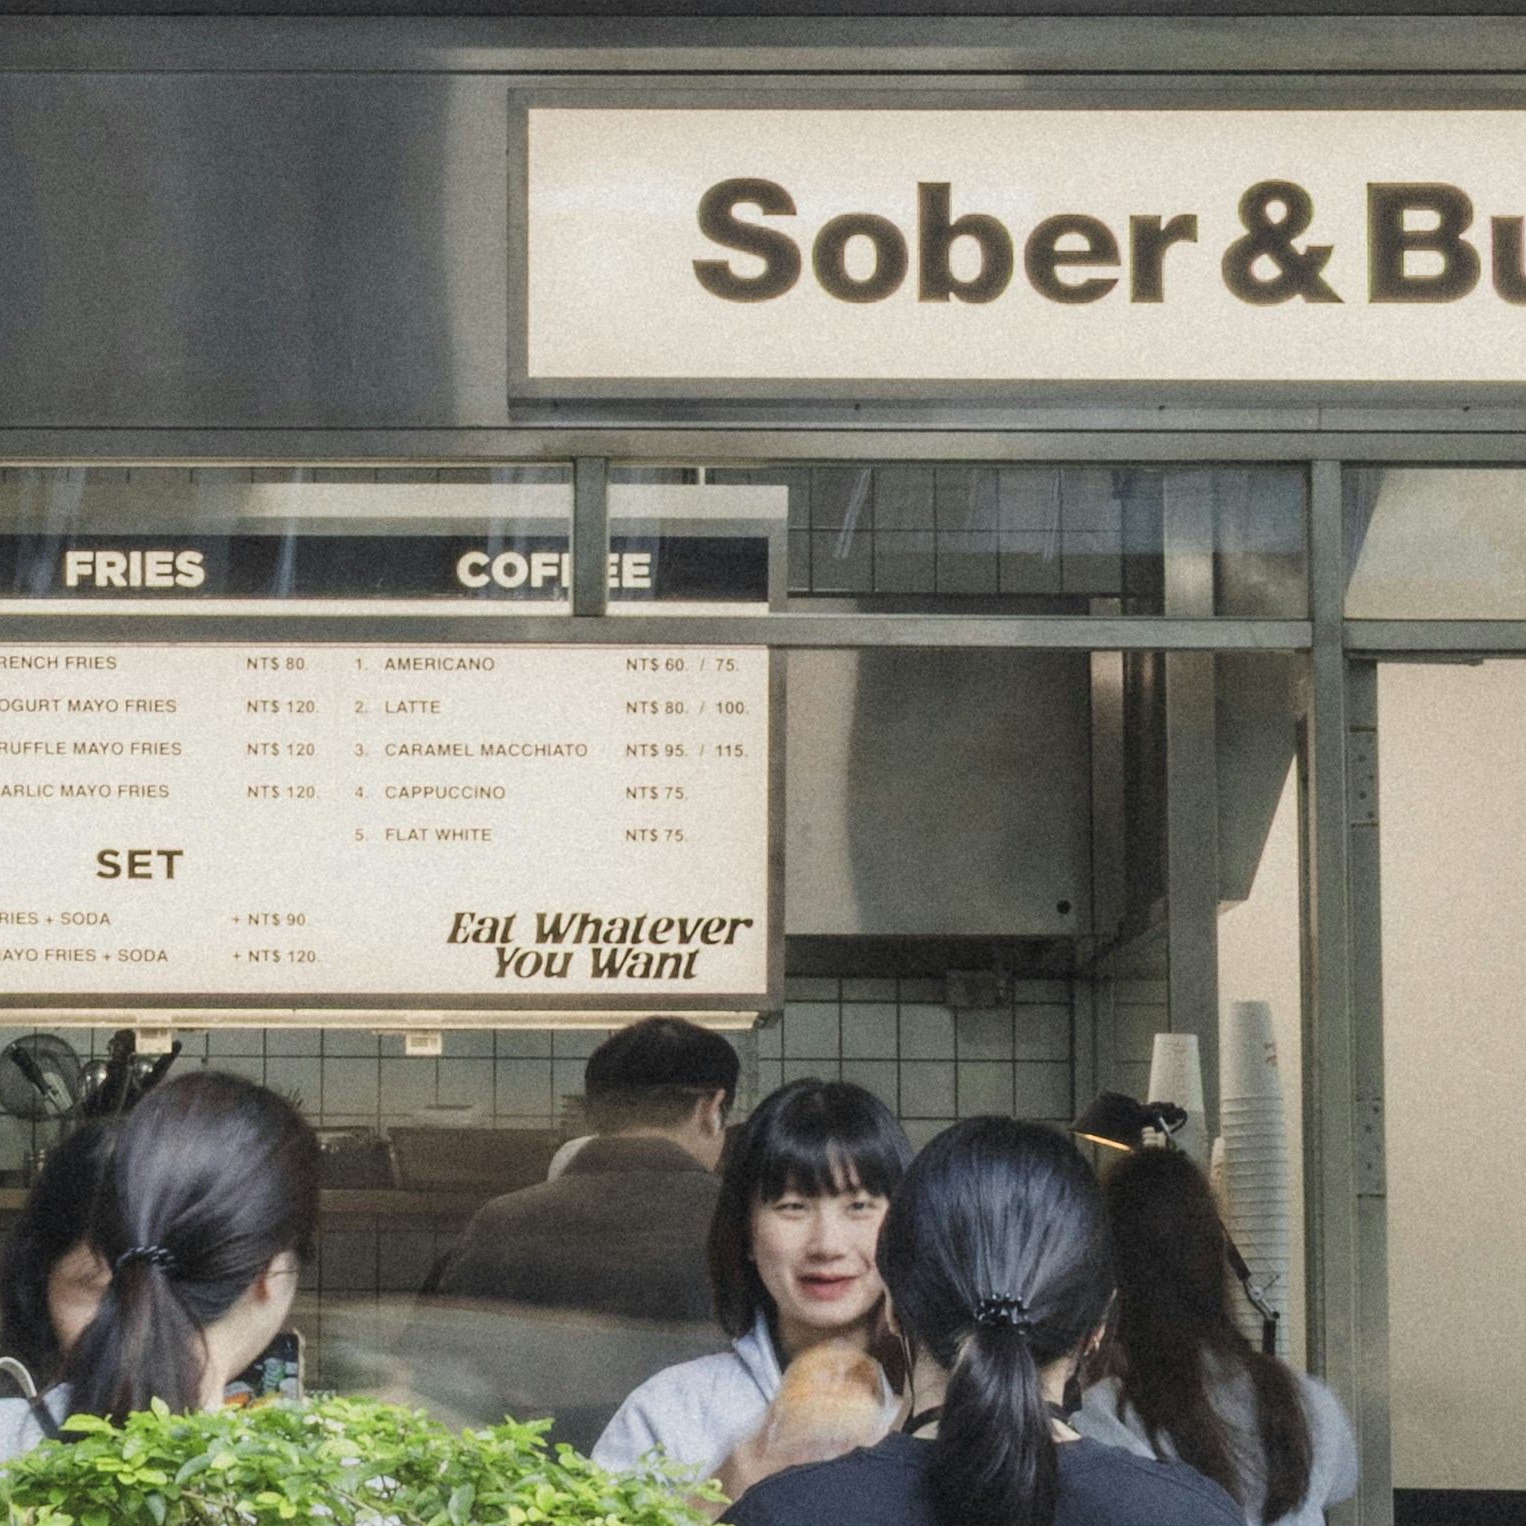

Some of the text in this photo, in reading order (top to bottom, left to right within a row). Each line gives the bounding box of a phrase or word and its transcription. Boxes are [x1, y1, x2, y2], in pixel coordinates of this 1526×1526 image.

[65, 550, 206, 588] FRIES
[64, 655, 118, 671] FRIES
[246, 655, 280, 671] NT$
[384, 657, 496, 672] AMERICANO
[625, 657, 659, 672] NT$
[67, 698, 119, 714] MAYO
[124, 698, 177, 714] FRIES
[246, 698, 280, 714] NT$
[384, 700, 441, 715] LATTE
[625, 700, 659, 715] NT$
[72, 741, 124, 757] MAYO
[130, 741, 182, 757] FRIES
[246, 741, 280, 757] NT$
[384, 743, 474, 758] CARAMEL
[480, 743, 589, 758] MACCHIATO
[625, 743, 659, 758] NT$
[59, 784, 112, 799] MAYO
[117, 784, 170, 799] FRIES
[247, 784, 280, 799] NT$
[384, 785, 506, 801] CAPPUCCINO
[625, 785, 659, 801] NT$
[384, 827, 428, 843] FLAT
[435, 827, 492, 843] WHITE
[625, 827, 659, 843] NT$
[95, 848, 185, 880] SET
[60, 911, 112, 927] SODA
[247, 911, 281, 927] NT$
[447, 911, 755, 946] Eat Whatever
[44, 948, 98, 964] FRIES
[117, 948, 169, 964] SODA
[247, 948, 281, 964] NT$
[494, 946, 701, 980] You Want
